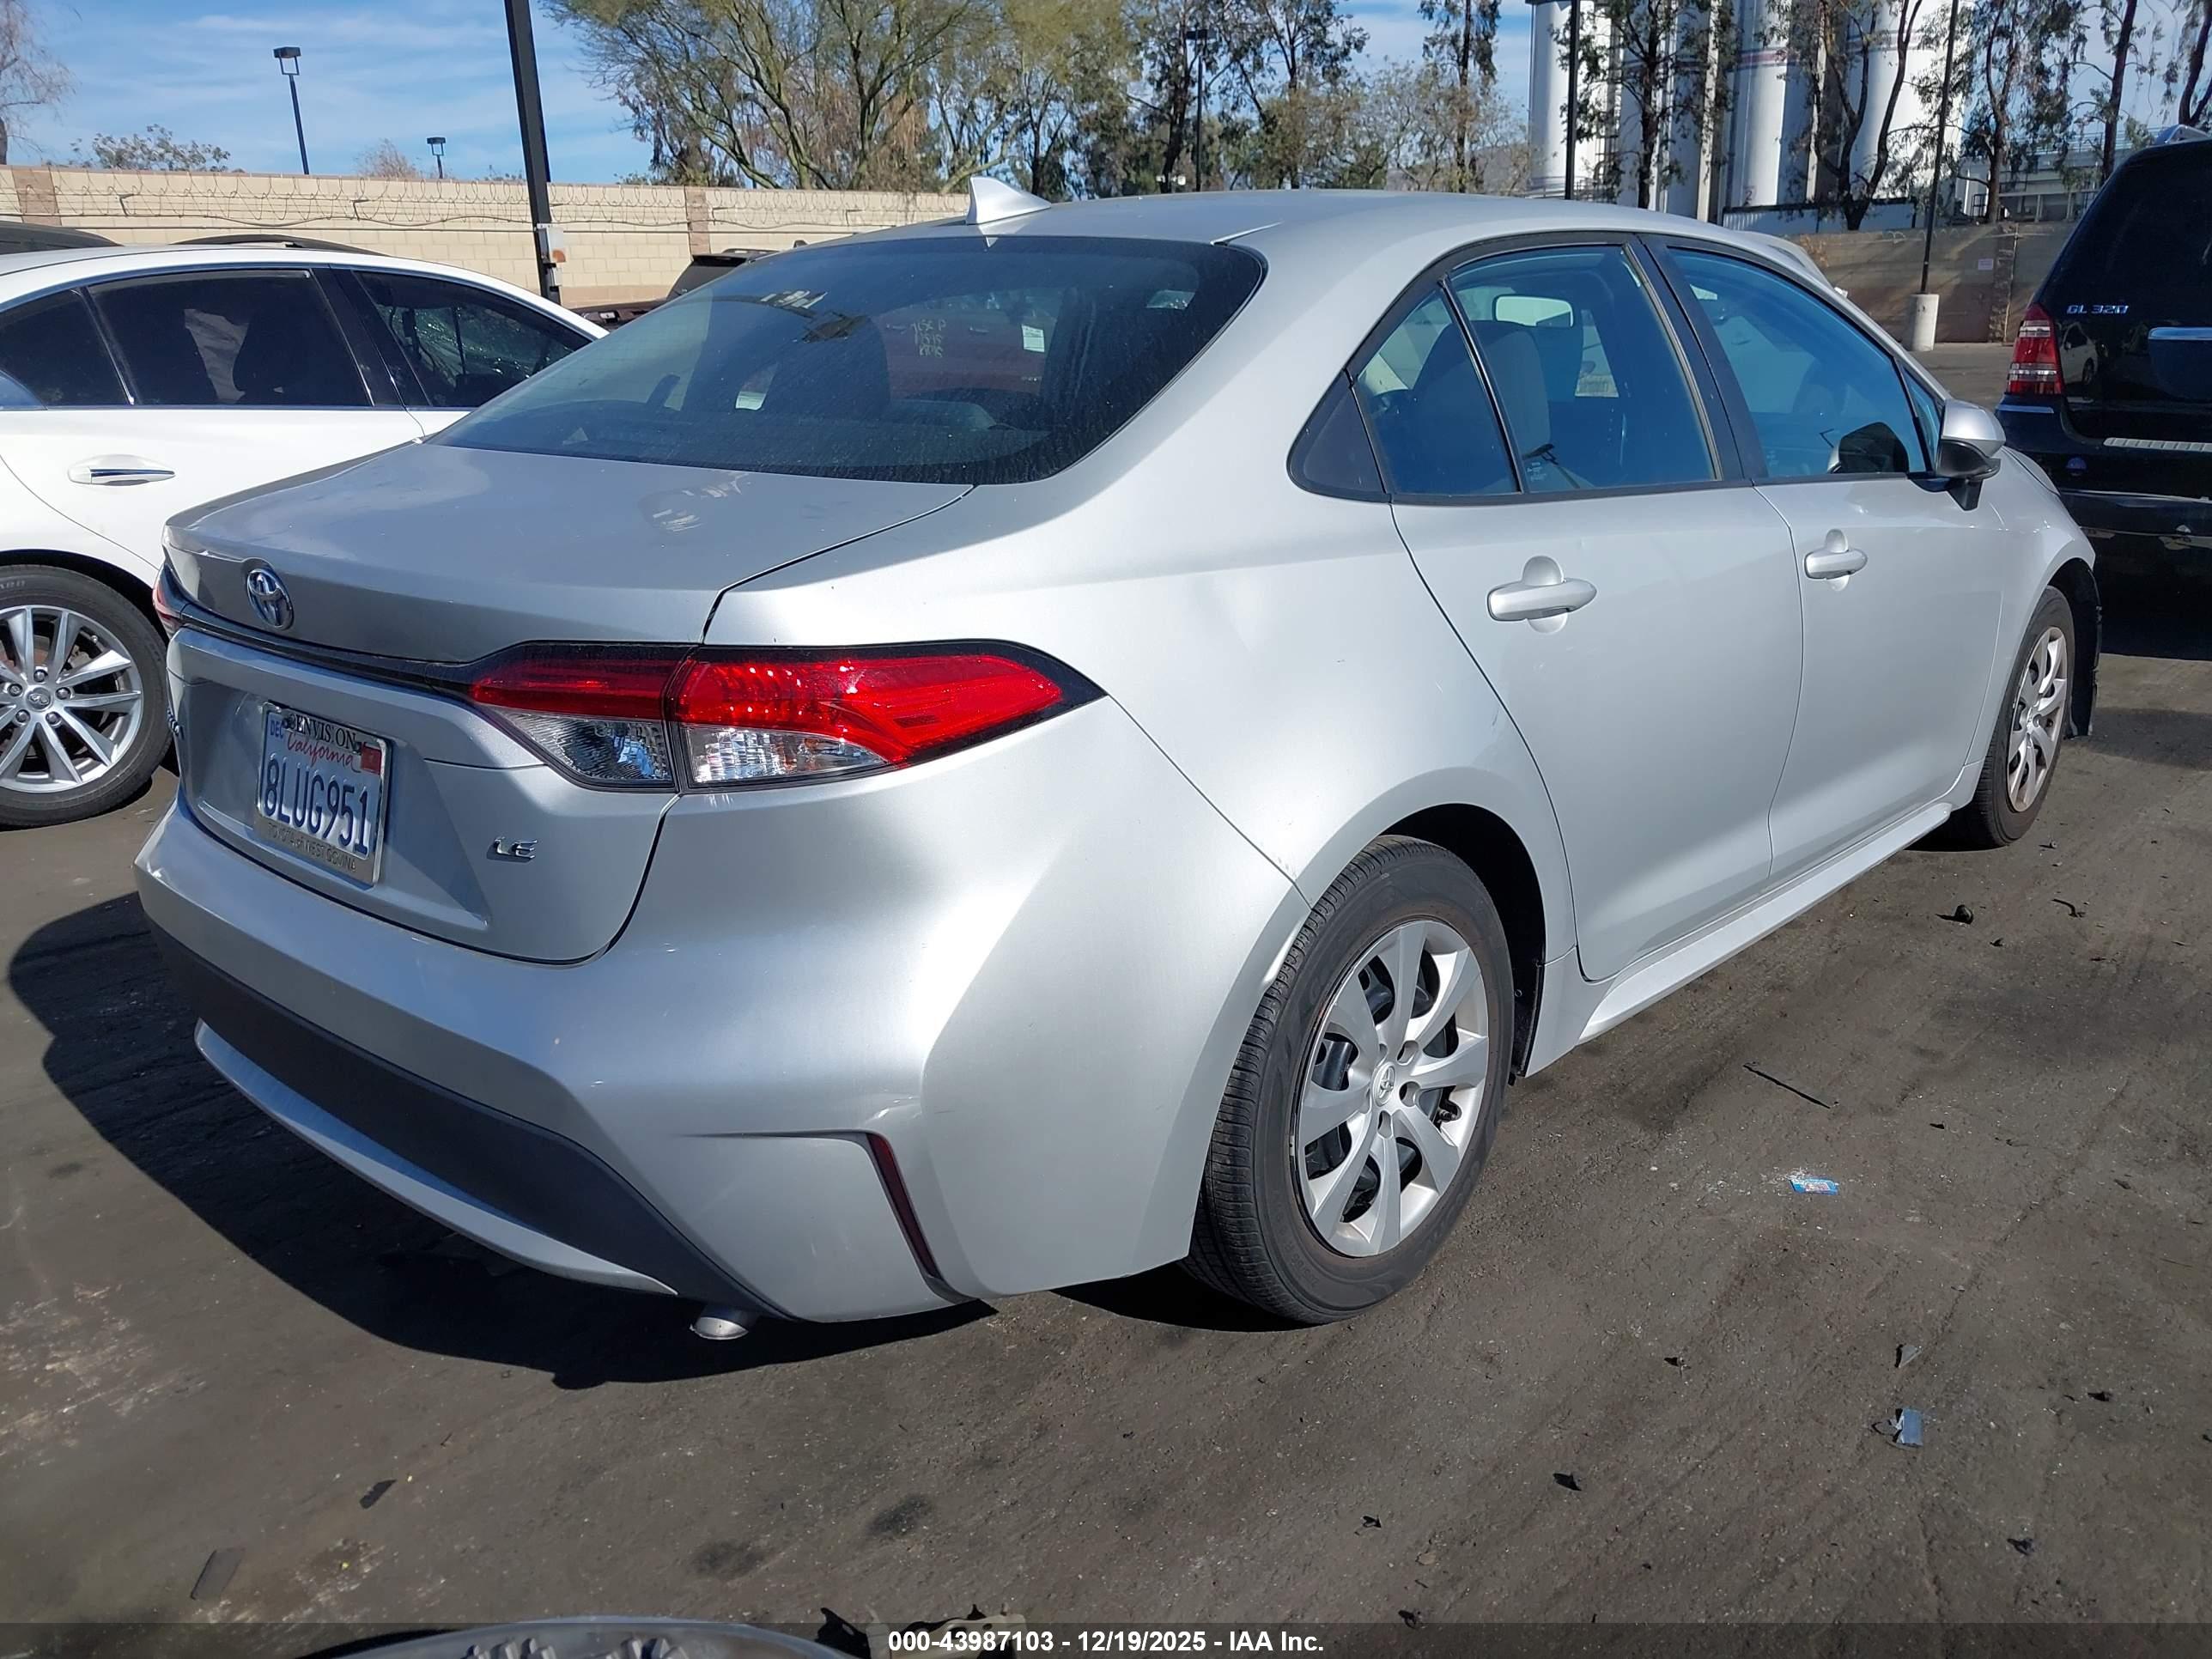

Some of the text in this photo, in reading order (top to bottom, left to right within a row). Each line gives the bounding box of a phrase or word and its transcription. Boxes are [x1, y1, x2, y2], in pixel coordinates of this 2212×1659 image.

[2066, 305, 2129, 314] GL 320
[287, 732, 361, 773] California
[265, 757, 368, 855] 8LUG951
[495, 836, 538, 859] LE
